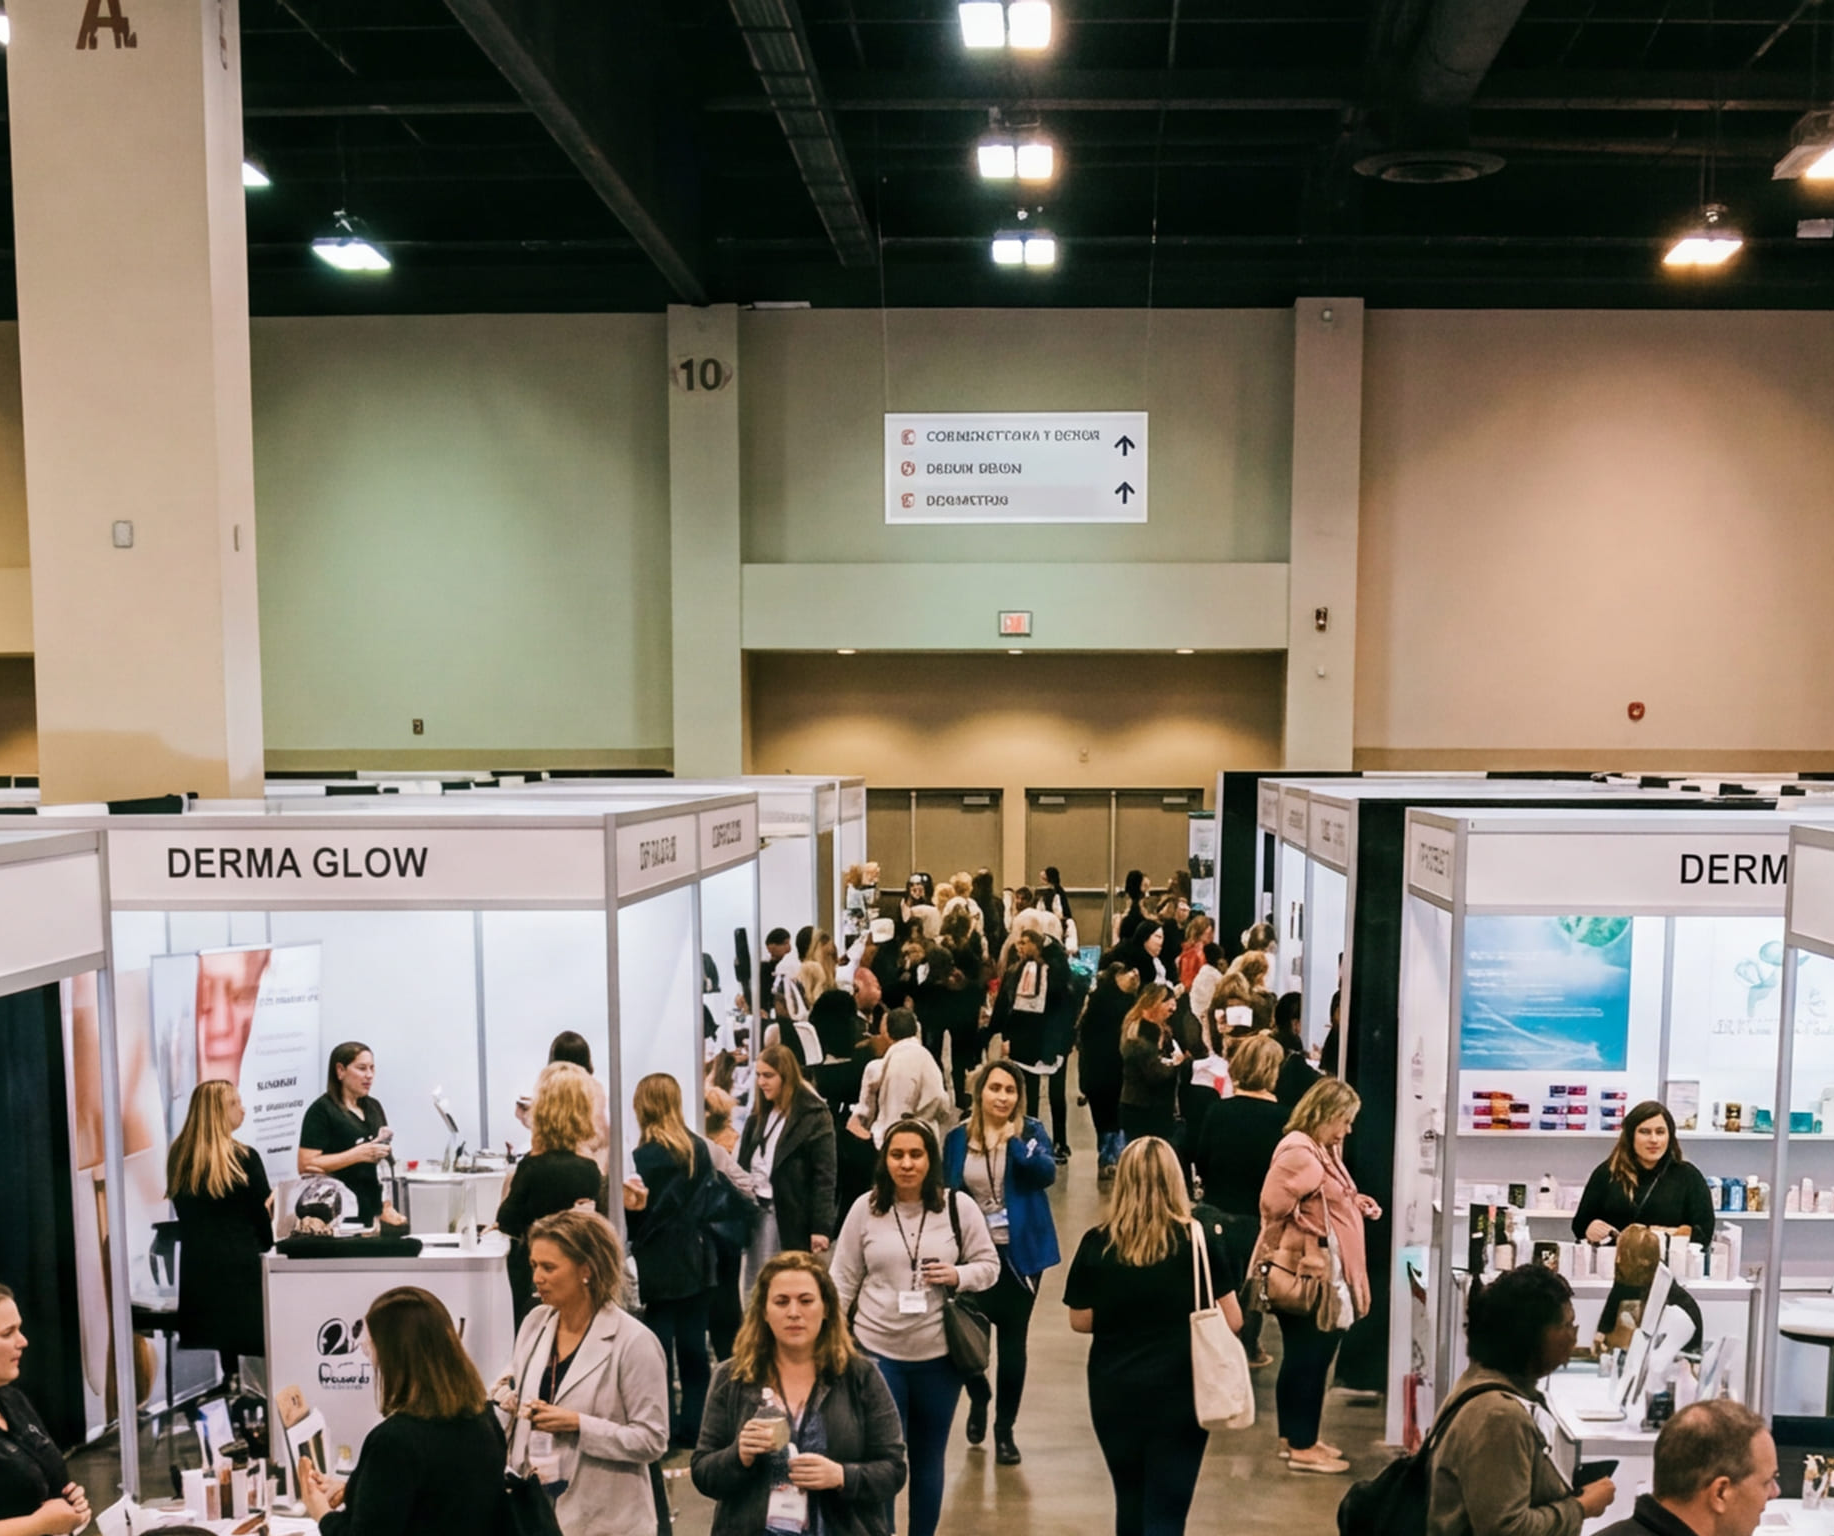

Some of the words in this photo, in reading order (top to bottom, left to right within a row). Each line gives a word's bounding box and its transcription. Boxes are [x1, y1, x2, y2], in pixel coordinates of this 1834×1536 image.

[679, 357, 723, 391] 10
[168, 848, 302, 878] DERMA
[313, 848, 428, 878] GLOW
[1681, 854, 1787, 885] DERM
